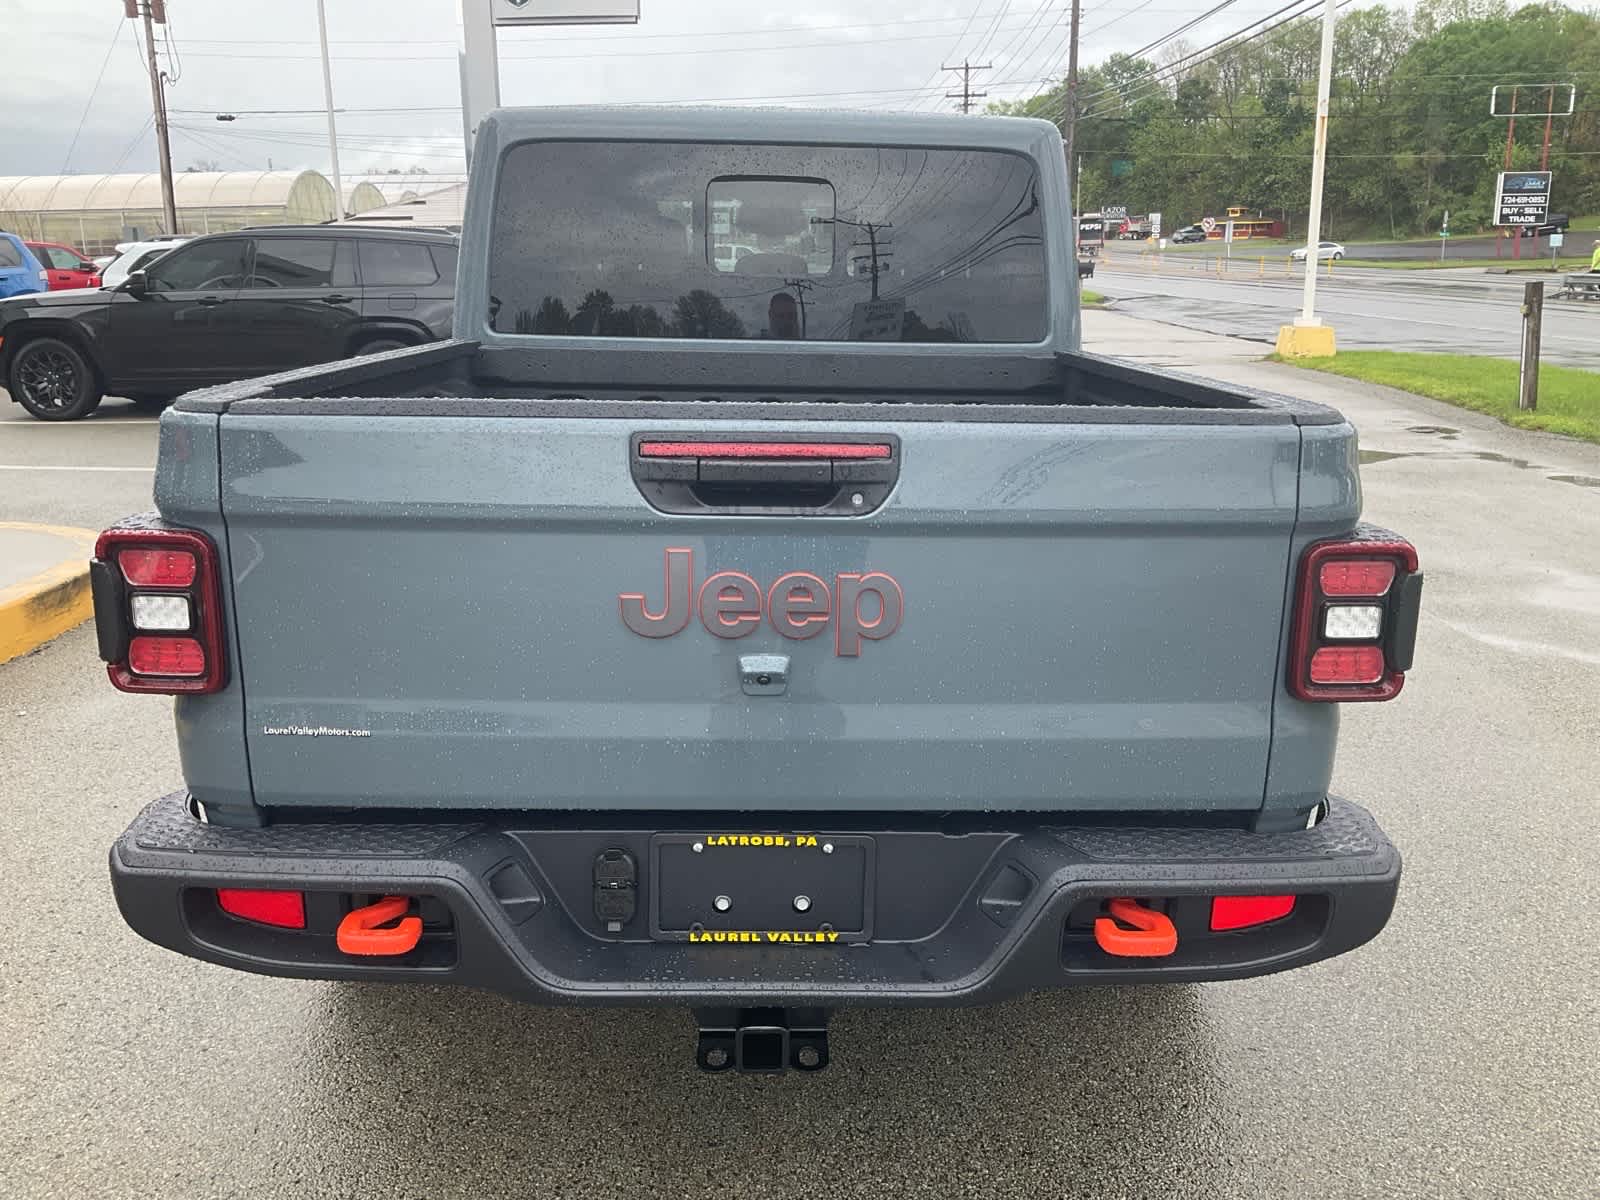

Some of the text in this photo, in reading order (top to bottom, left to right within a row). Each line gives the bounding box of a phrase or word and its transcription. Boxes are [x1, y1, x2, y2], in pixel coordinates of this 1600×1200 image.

[618, 547, 904, 657] Jeep
[263, 725, 371, 738] LaurelValleyMotors.com
[706, 835, 818, 847] LATROBE, PA
[688, 932, 840, 943] LAUREL VALLEY
